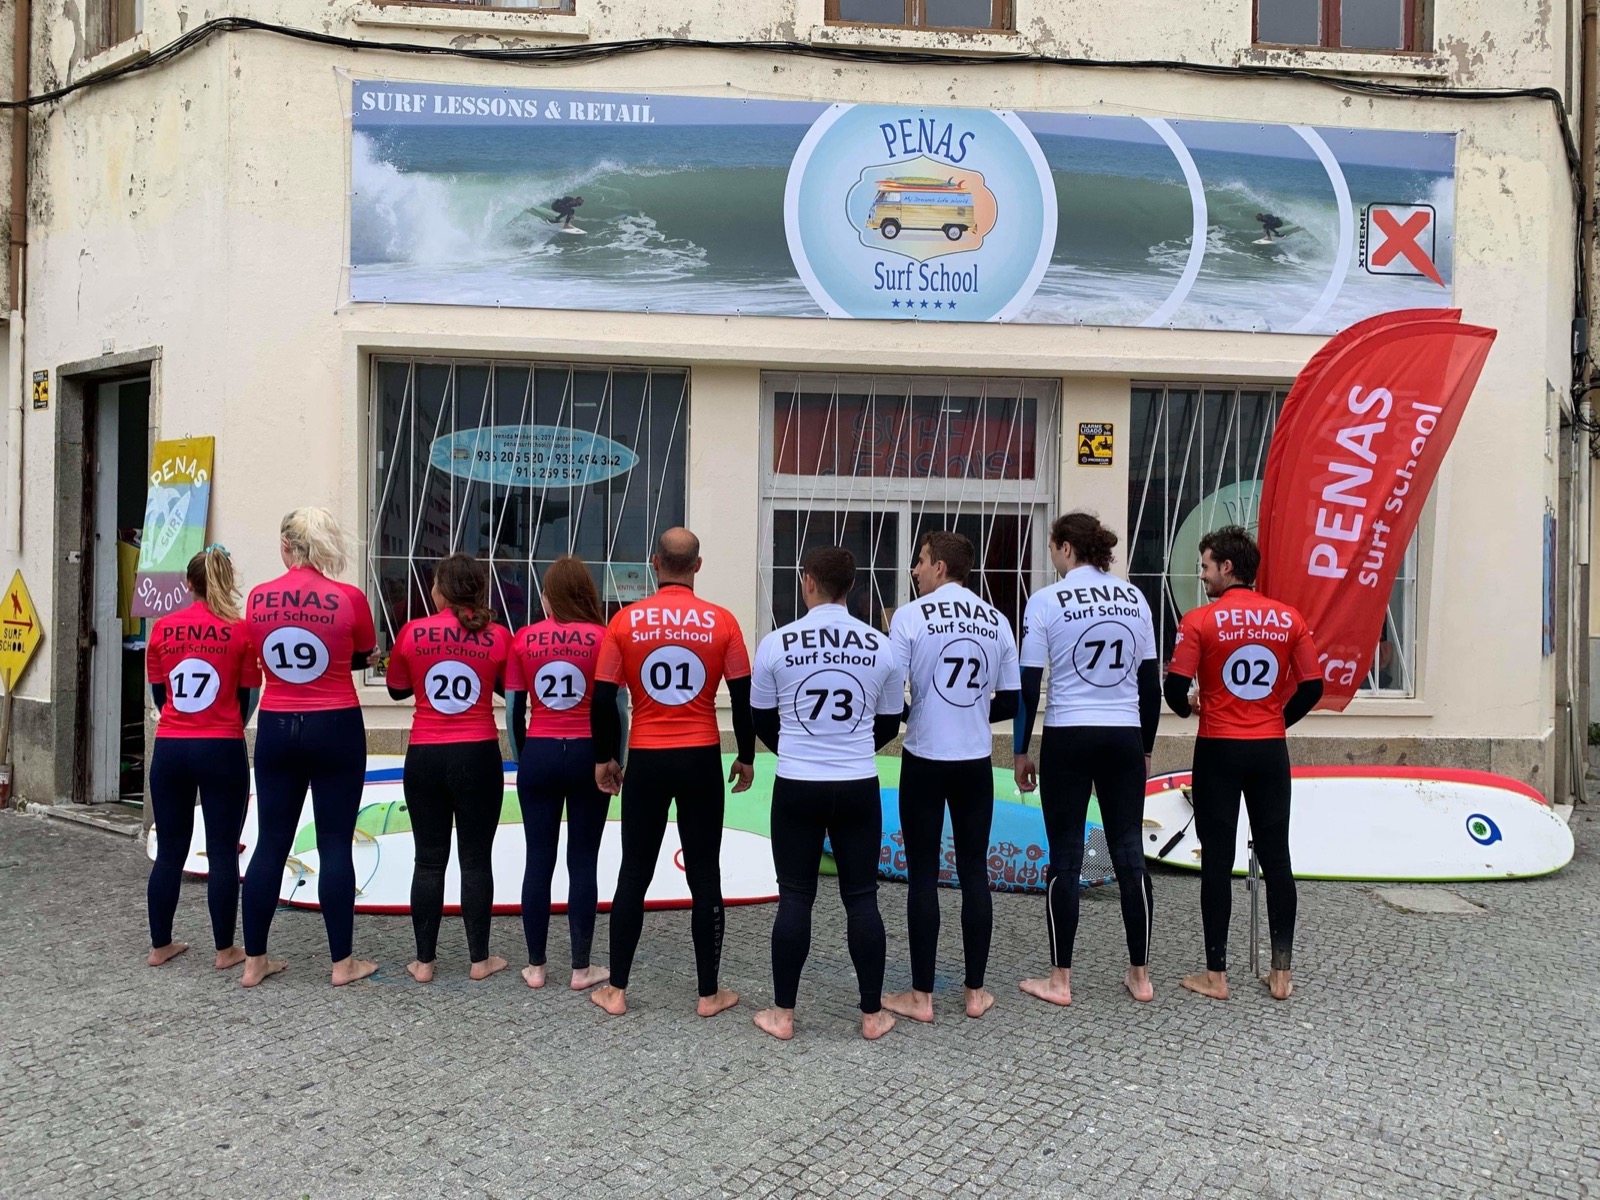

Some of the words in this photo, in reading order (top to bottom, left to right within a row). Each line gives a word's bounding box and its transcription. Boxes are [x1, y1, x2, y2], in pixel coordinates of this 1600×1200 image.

[361, 92, 427, 113] SURF
[434, 95, 538, 119] LESSONS
[544, 100, 562, 120] &
[569, 102, 655, 124] RETAIL
[879, 118, 975, 163] PENAS
[1358, 207, 1367, 268] XTREME
[874, 261, 914, 291] Surf
[918, 262, 979, 293] School
[151, 456, 207, 488] PENAS
[1307, 385, 1393, 579] PENAS
[160, 508, 185, 548] SURF
[253, 590, 339, 611] PENAS
[1056, 585, 1138, 608] PENAS
[252, 610, 279, 624] Surf
[283, 610, 335, 624] School
[630, 608, 715, 628] PENAS
[921, 601, 999, 626] PENAS
[1063, 606, 1094, 622] Surf
[1098, 604, 1140, 618] School
[1214, 608, 1293, 628] PENAS
[4, 628, 22, 640] SURF
[163, 625, 232, 642] PENAS
[413, 627, 495, 648] PENAS
[526, 630, 595, 647] PENAS
[632, 628, 661, 643] Surf
[665, 628, 713, 643] School
[782, 628, 879, 652] PENAS
[927, 621, 954, 635] Surf
[958, 621, 998, 641] School
[1218, 628, 1245, 642] Surf
[1247, 628, 1289, 643] School
[163, 643, 186, 654] Surf
[188, 644, 227, 654] School
[271, 642, 316, 669] 19
[415, 645, 442, 657] Surf
[445, 645, 490, 660] School
[527, 648, 549, 659] Surf
[552, 646, 592, 658] School
[785, 651, 818, 667] Surf
[823, 651, 876, 668] School
[1084, 639, 1124, 669] 71
[650, 662, 693, 690] 01
[944, 657, 980, 688] 72
[1231, 659, 1270, 686] 02
[174, 672, 211, 698] 17
[433, 674, 472, 701] 20
[541, 674, 577, 698] 21
[805, 689, 853, 721] 73
